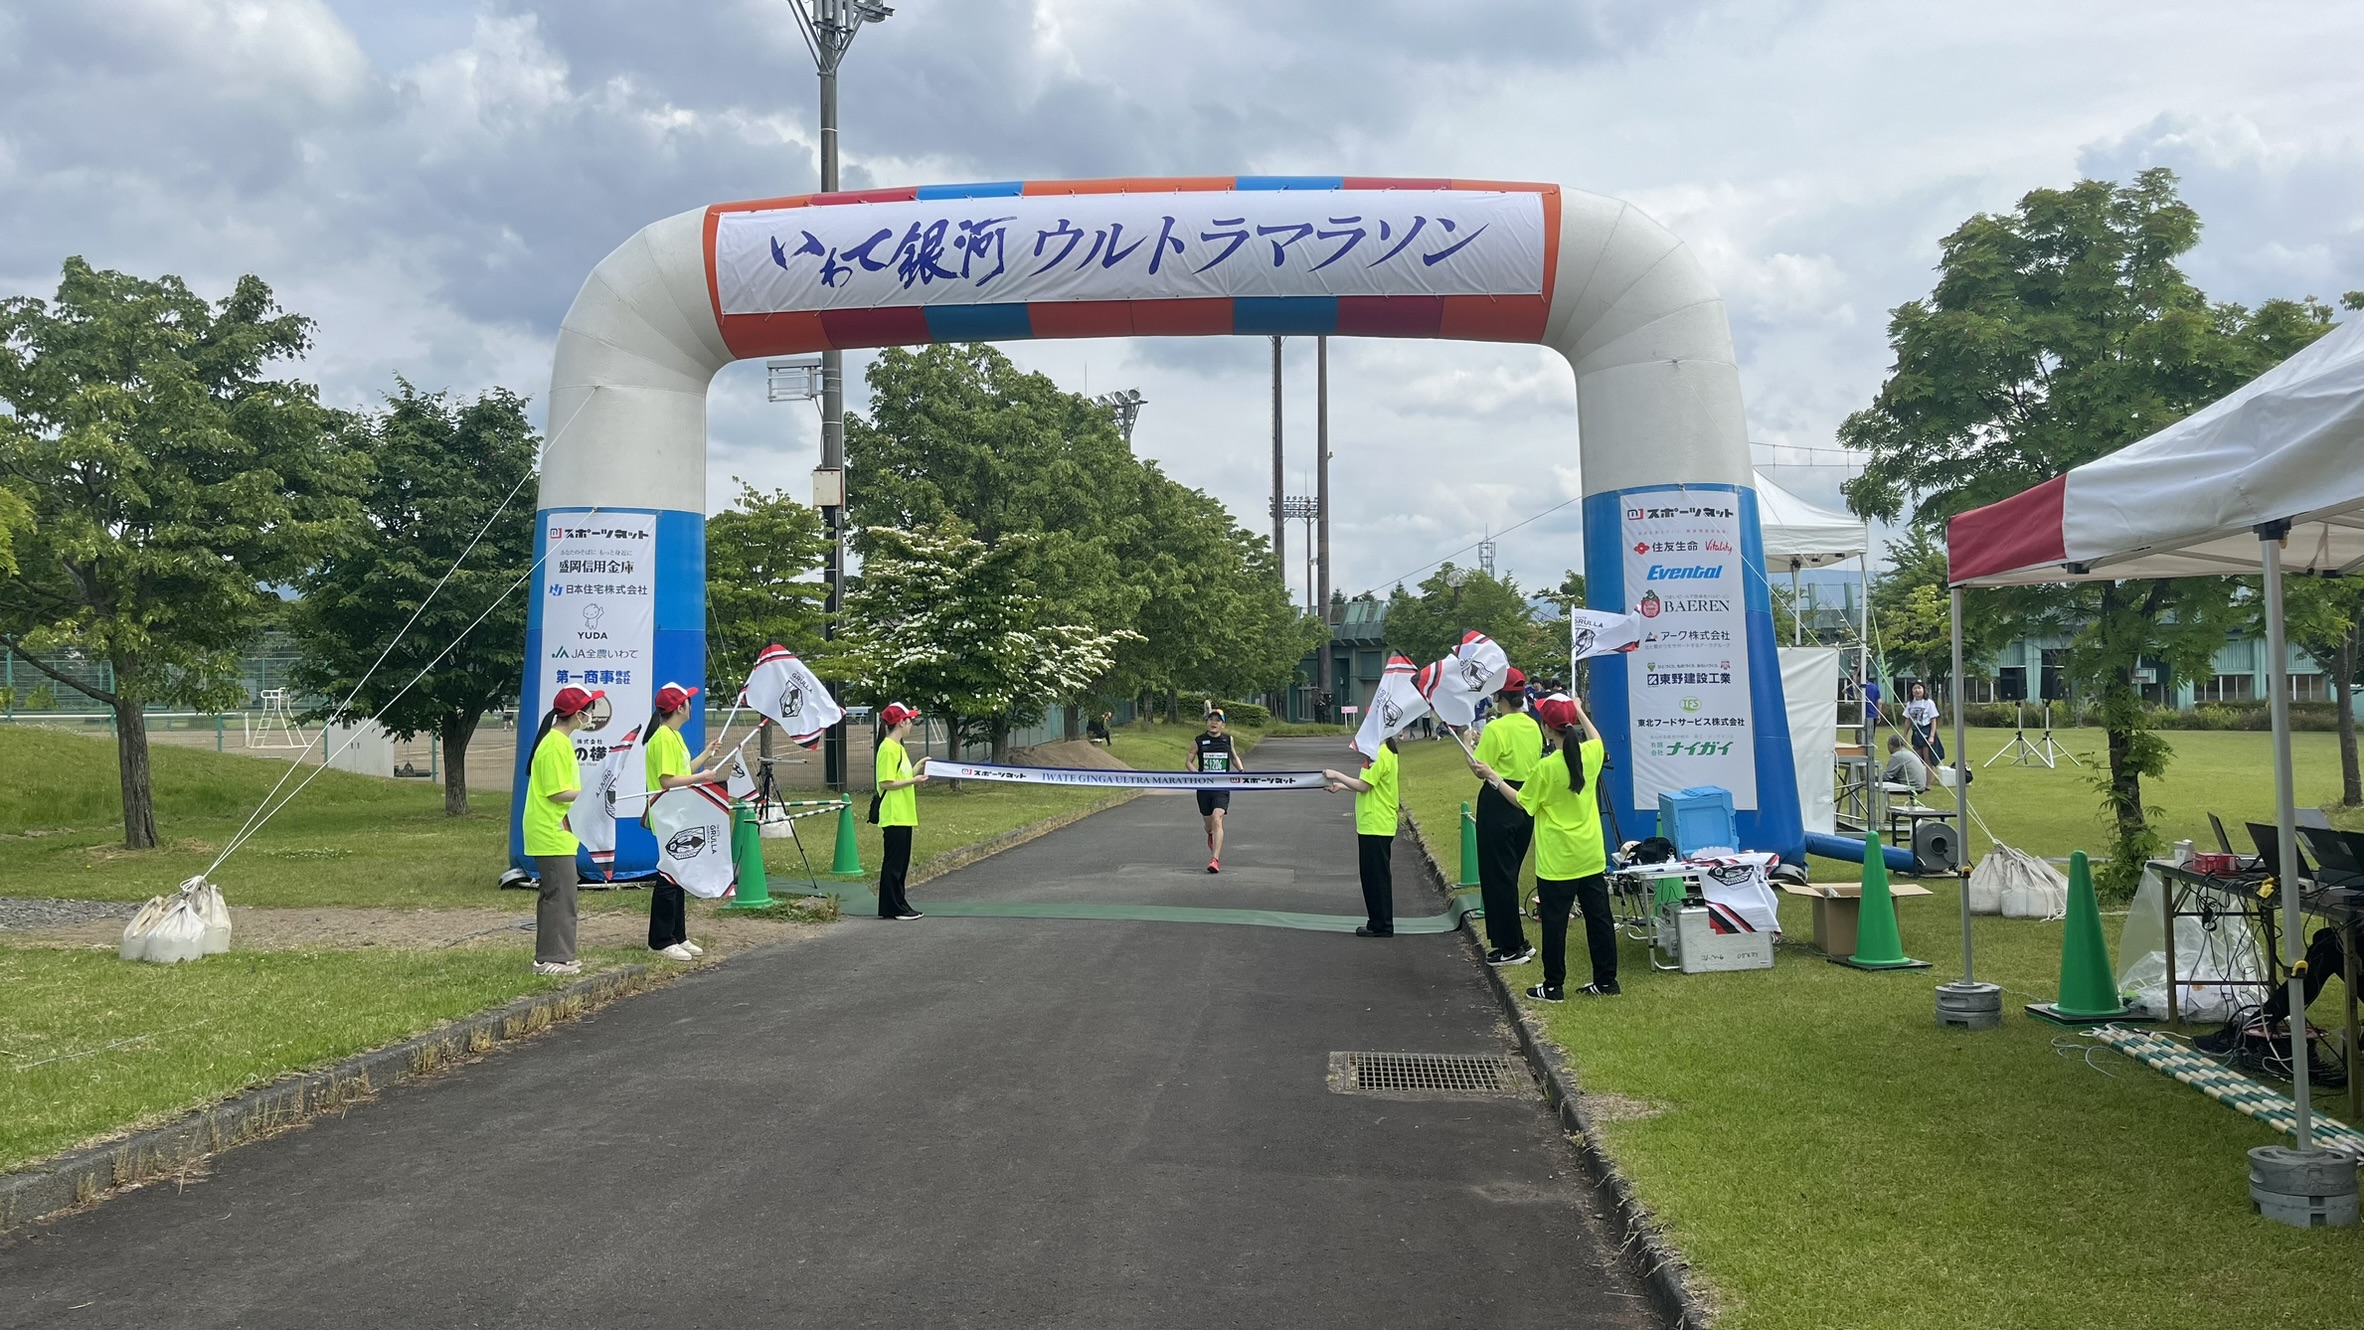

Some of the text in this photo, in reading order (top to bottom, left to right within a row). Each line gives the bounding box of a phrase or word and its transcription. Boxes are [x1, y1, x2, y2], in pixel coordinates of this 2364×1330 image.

[770, 216, 1489, 289] いわて銀河 ウルトラマラソン
[1647, 507, 1734, 519] スポーツネット
[564, 528, 649, 540] スポーツネット
[1652, 540, 1698, 552] 住友生命
[1705, 539, 1733, 556] Vitality
[559, 560, 634, 574] 盛岡信用金庫
[566, 585, 648, 596] 日本住宅株式会社
[1664, 599, 1730, 612] BAEREN
[578, 631, 608, 640] YUDA
[1661, 630, 1730, 641] アーク株式会社
[571, 649, 639, 659] JA全農いわて
[556, 670, 614, 684] 第一商事
[791, 672, 813, 694] GRULLA
[1660, 673, 1731, 685] 東野建設工業
[1683, 699, 1699, 709] TFS
[1637, 717, 1745, 727] 東北フードサービス株式会社
[1667, 742, 1733, 756] ナイガイ
[974, 769, 1027, 779] スポーツネット
[1042, 773, 1215, 785] IWATE GINGA ULTRA MARATHON
